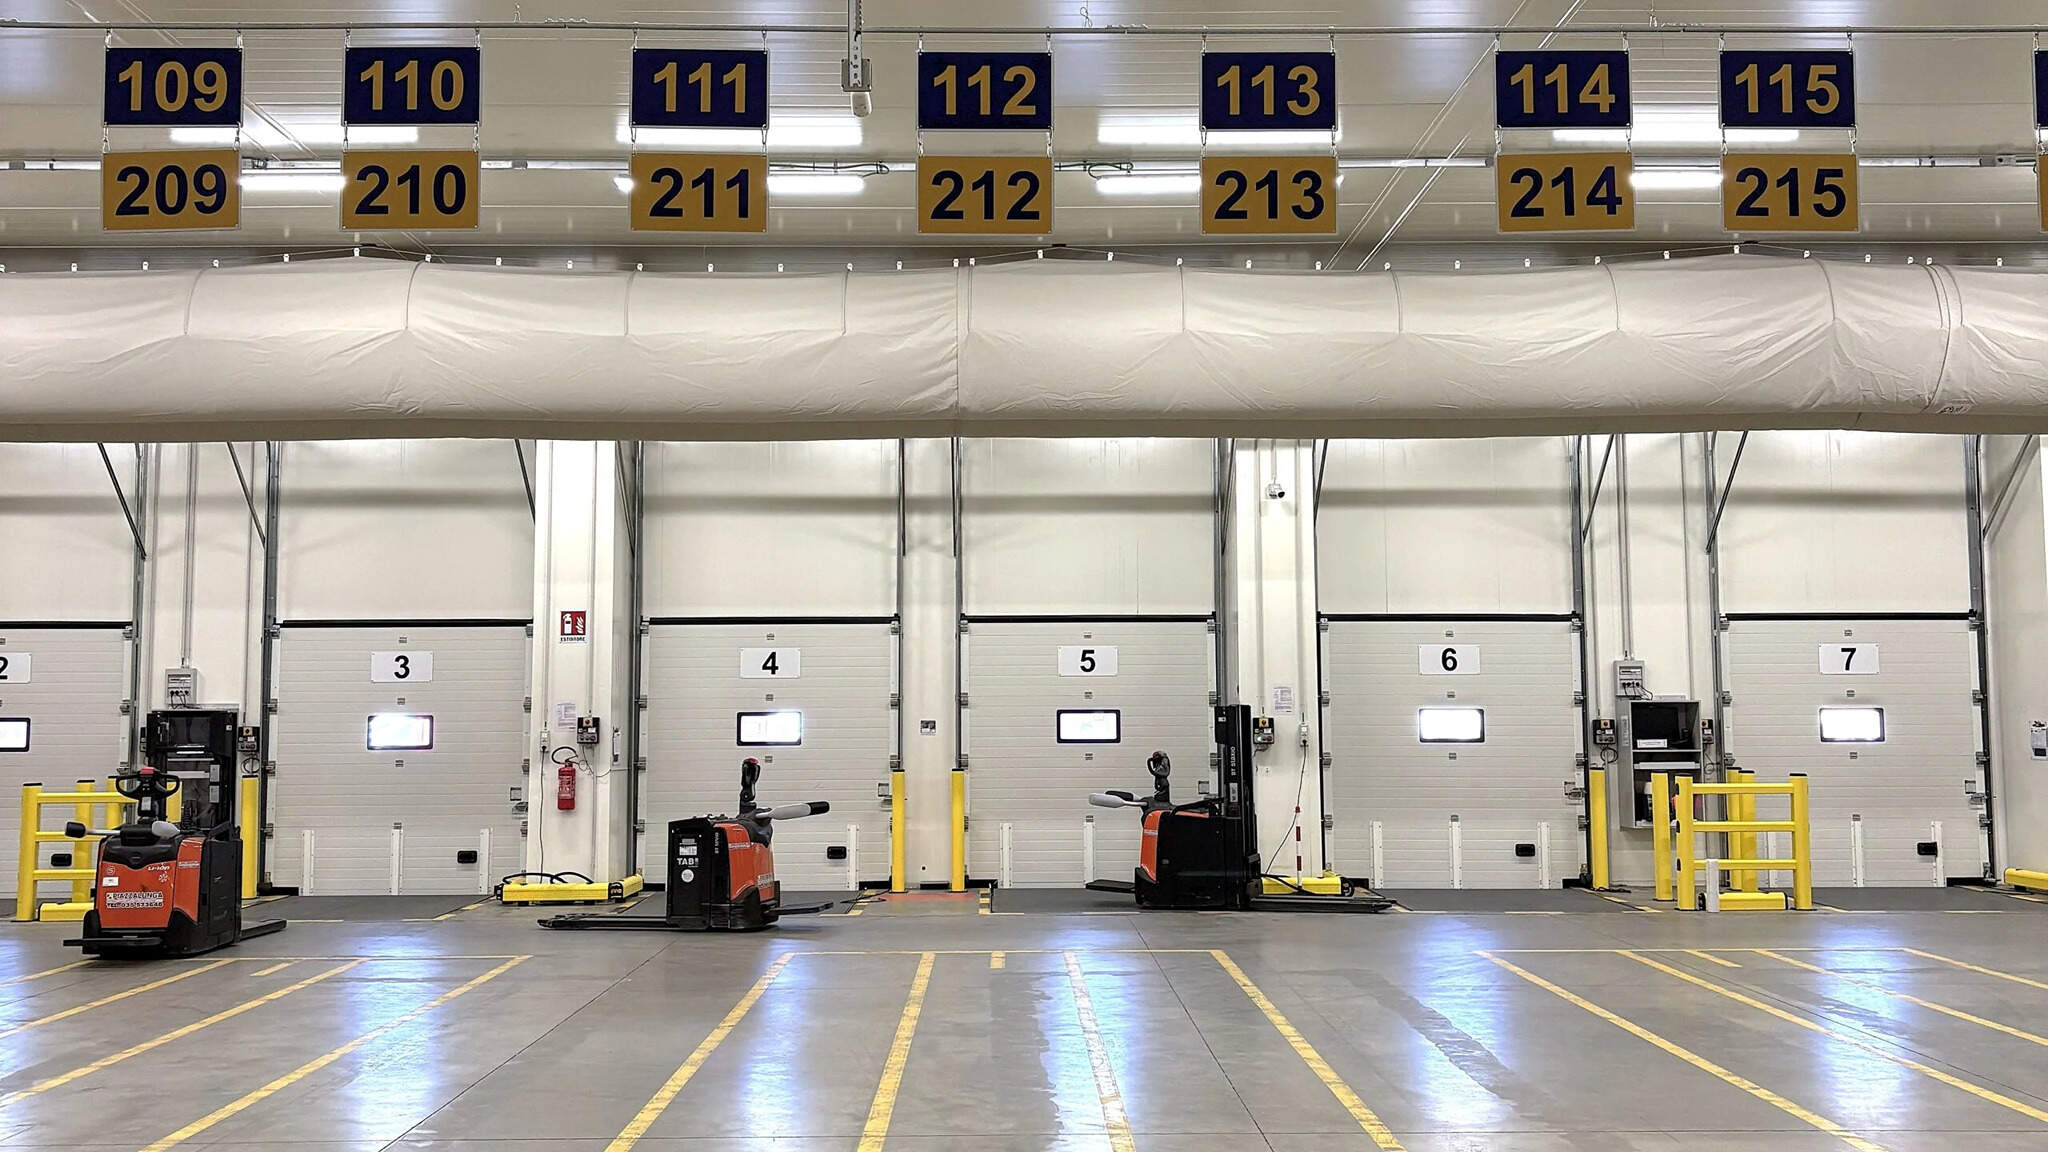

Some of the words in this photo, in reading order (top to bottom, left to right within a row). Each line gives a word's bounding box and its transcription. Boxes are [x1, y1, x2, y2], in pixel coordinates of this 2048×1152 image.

[118, 62, 227, 112] 109
[360, 61, 464, 111] 110
[653, 64, 747, 113] 111
[933, 66, 1036, 116] 112
[1218, 66, 1320, 116] 113
[1510, 64, 1615, 113] 114
[1735, 64, 1839, 113] 115
[116, 164, 226, 216] 209
[355, 165, 466, 214] 210
[649, 168, 750, 218] 211
[930, 171, 1041, 221] 212
[1213, 170, 1325, 220] 213
[1510, 166, 1623, 217] 214
[1736, 168, 1847, 218] 215
[394, 656, 410, 679] 3
[761, 651, 779, 675] 4
[1080, 650, 1096, 673] 5
[1441, 648, 1458, 672] 6
[1841, 648, 1857, 671] 7
[677, 857, 695, 865] TAB
